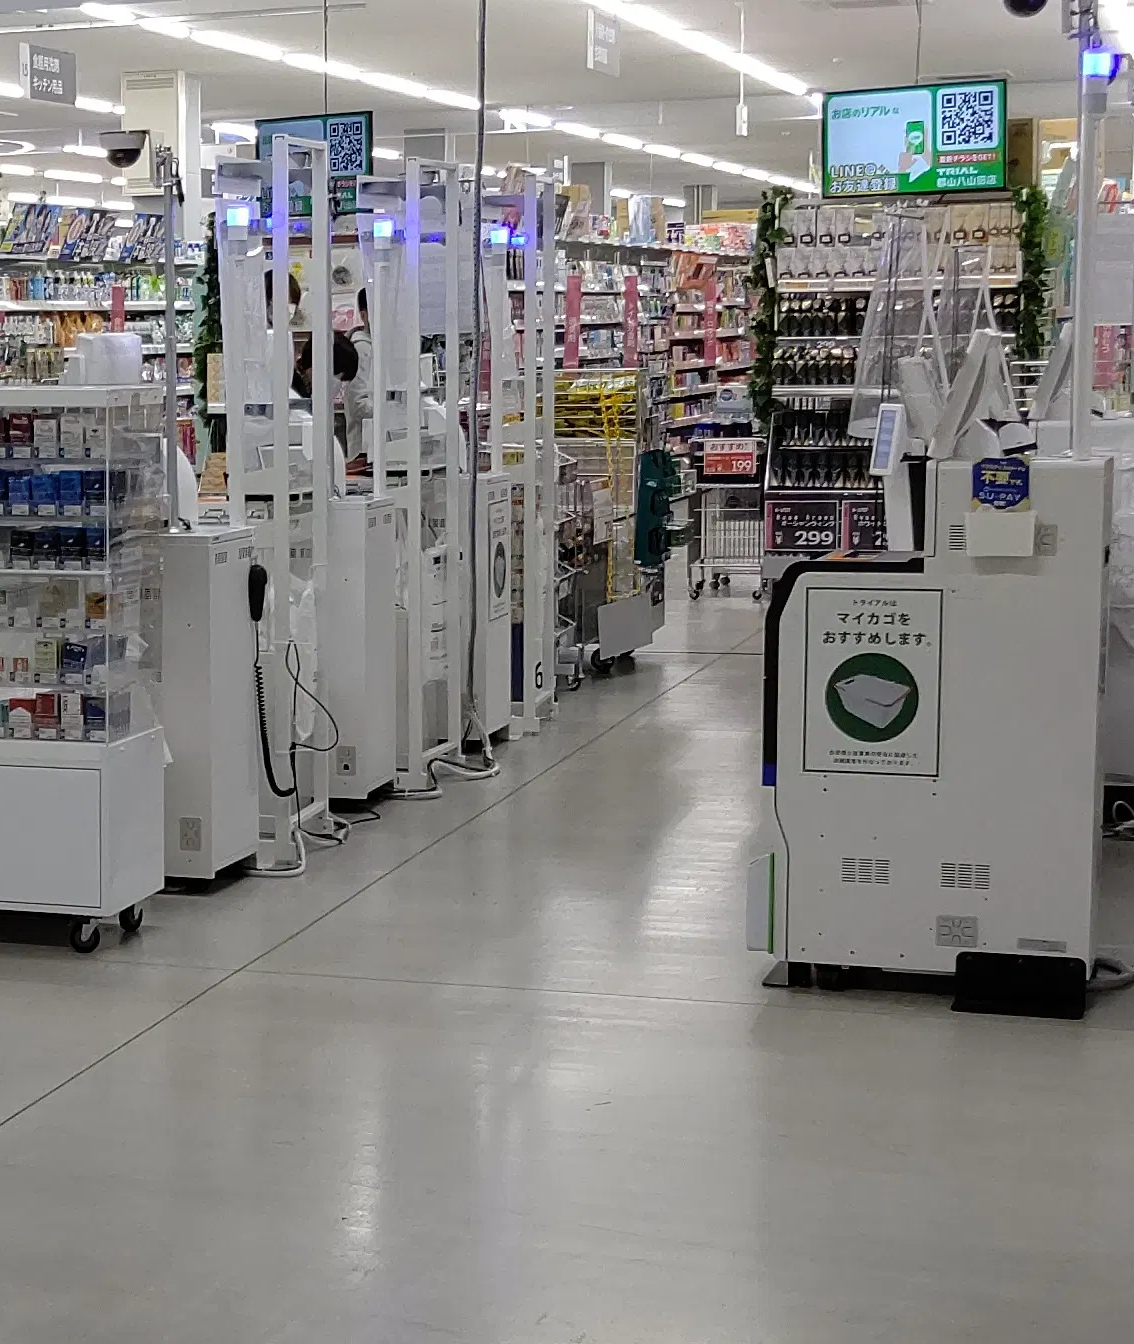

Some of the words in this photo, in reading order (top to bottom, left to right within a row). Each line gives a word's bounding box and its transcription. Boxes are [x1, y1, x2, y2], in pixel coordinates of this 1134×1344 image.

[936, 167, 978, 176] TRIAL
[731, 460, 752, 472] 199
[794, 530, 834, 545] 299
[852, 599, 898, 607] トライアルは
[836, 612, 911, 626] マイカゴを
[822, 630, 933, 647] おすすめします。
[535, 661, 543, 689] 6
